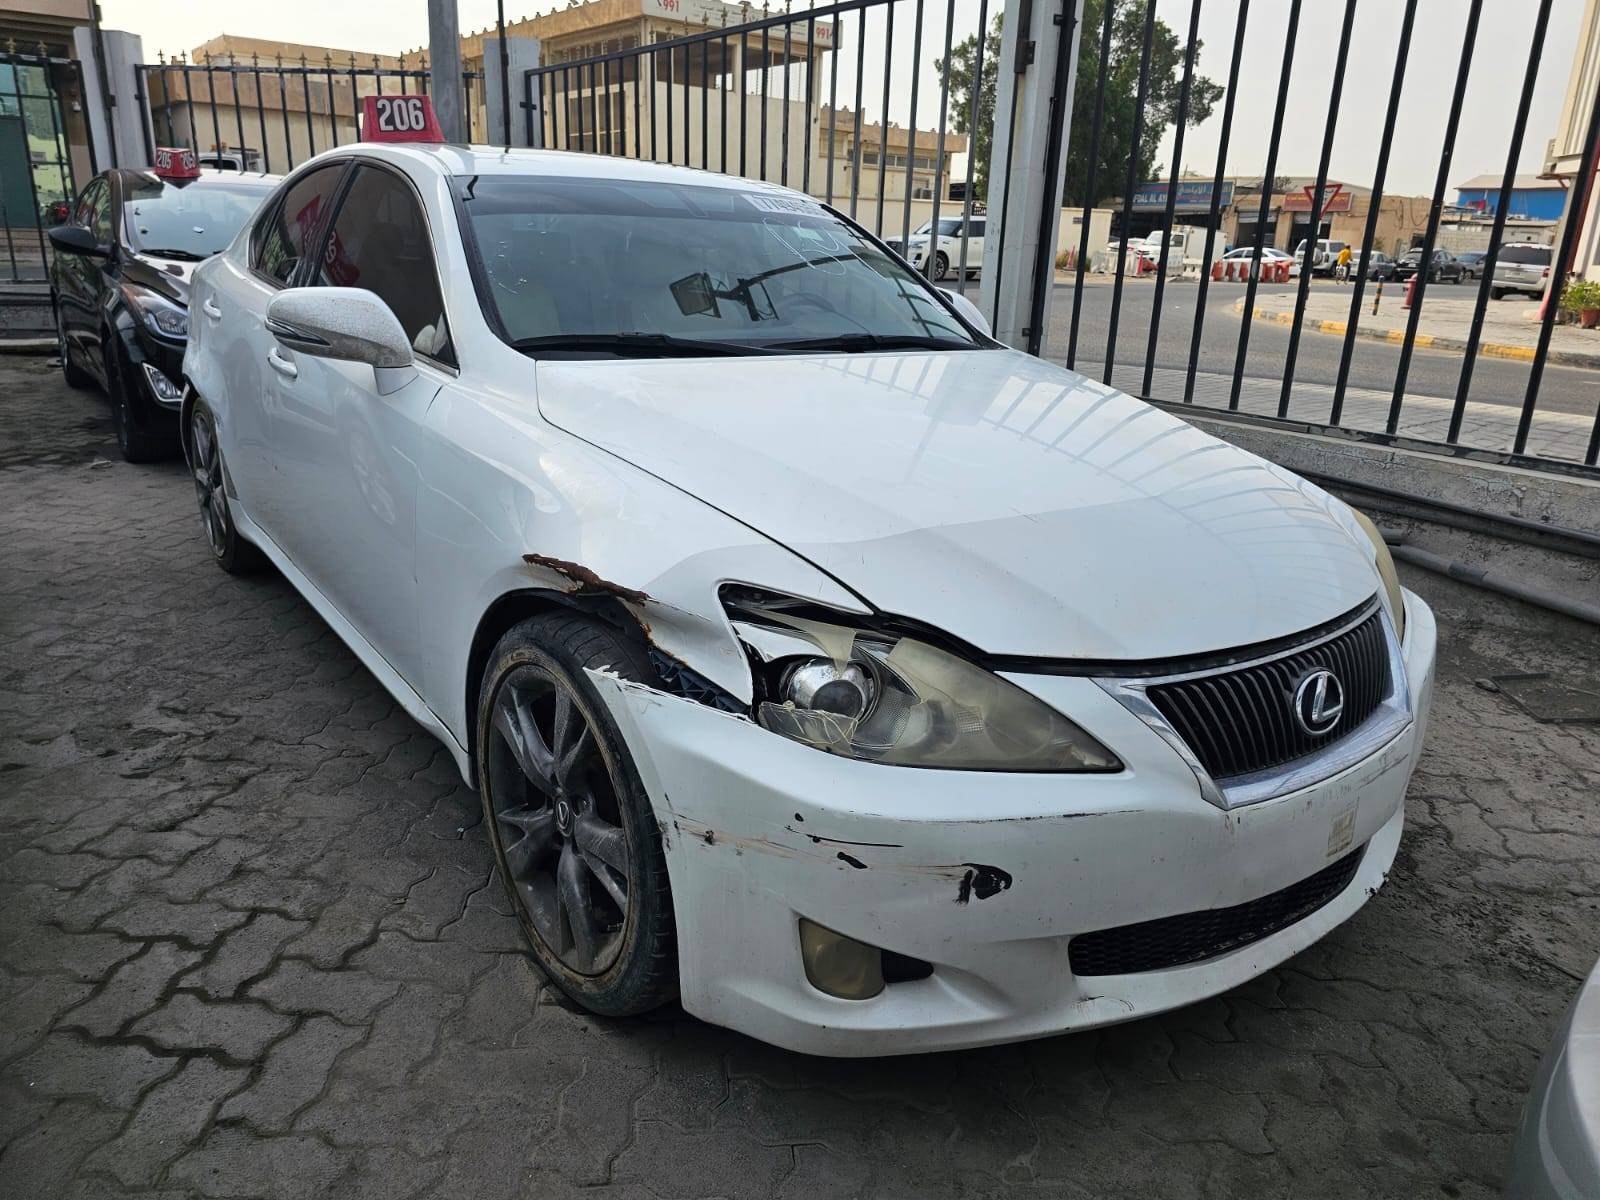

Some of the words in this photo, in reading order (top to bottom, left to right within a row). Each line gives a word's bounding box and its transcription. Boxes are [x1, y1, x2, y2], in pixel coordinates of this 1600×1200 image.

[816, 26, 830, 40] 991
[377, 98, 425, 131] 206
[157, 151, 172, 170] 205
